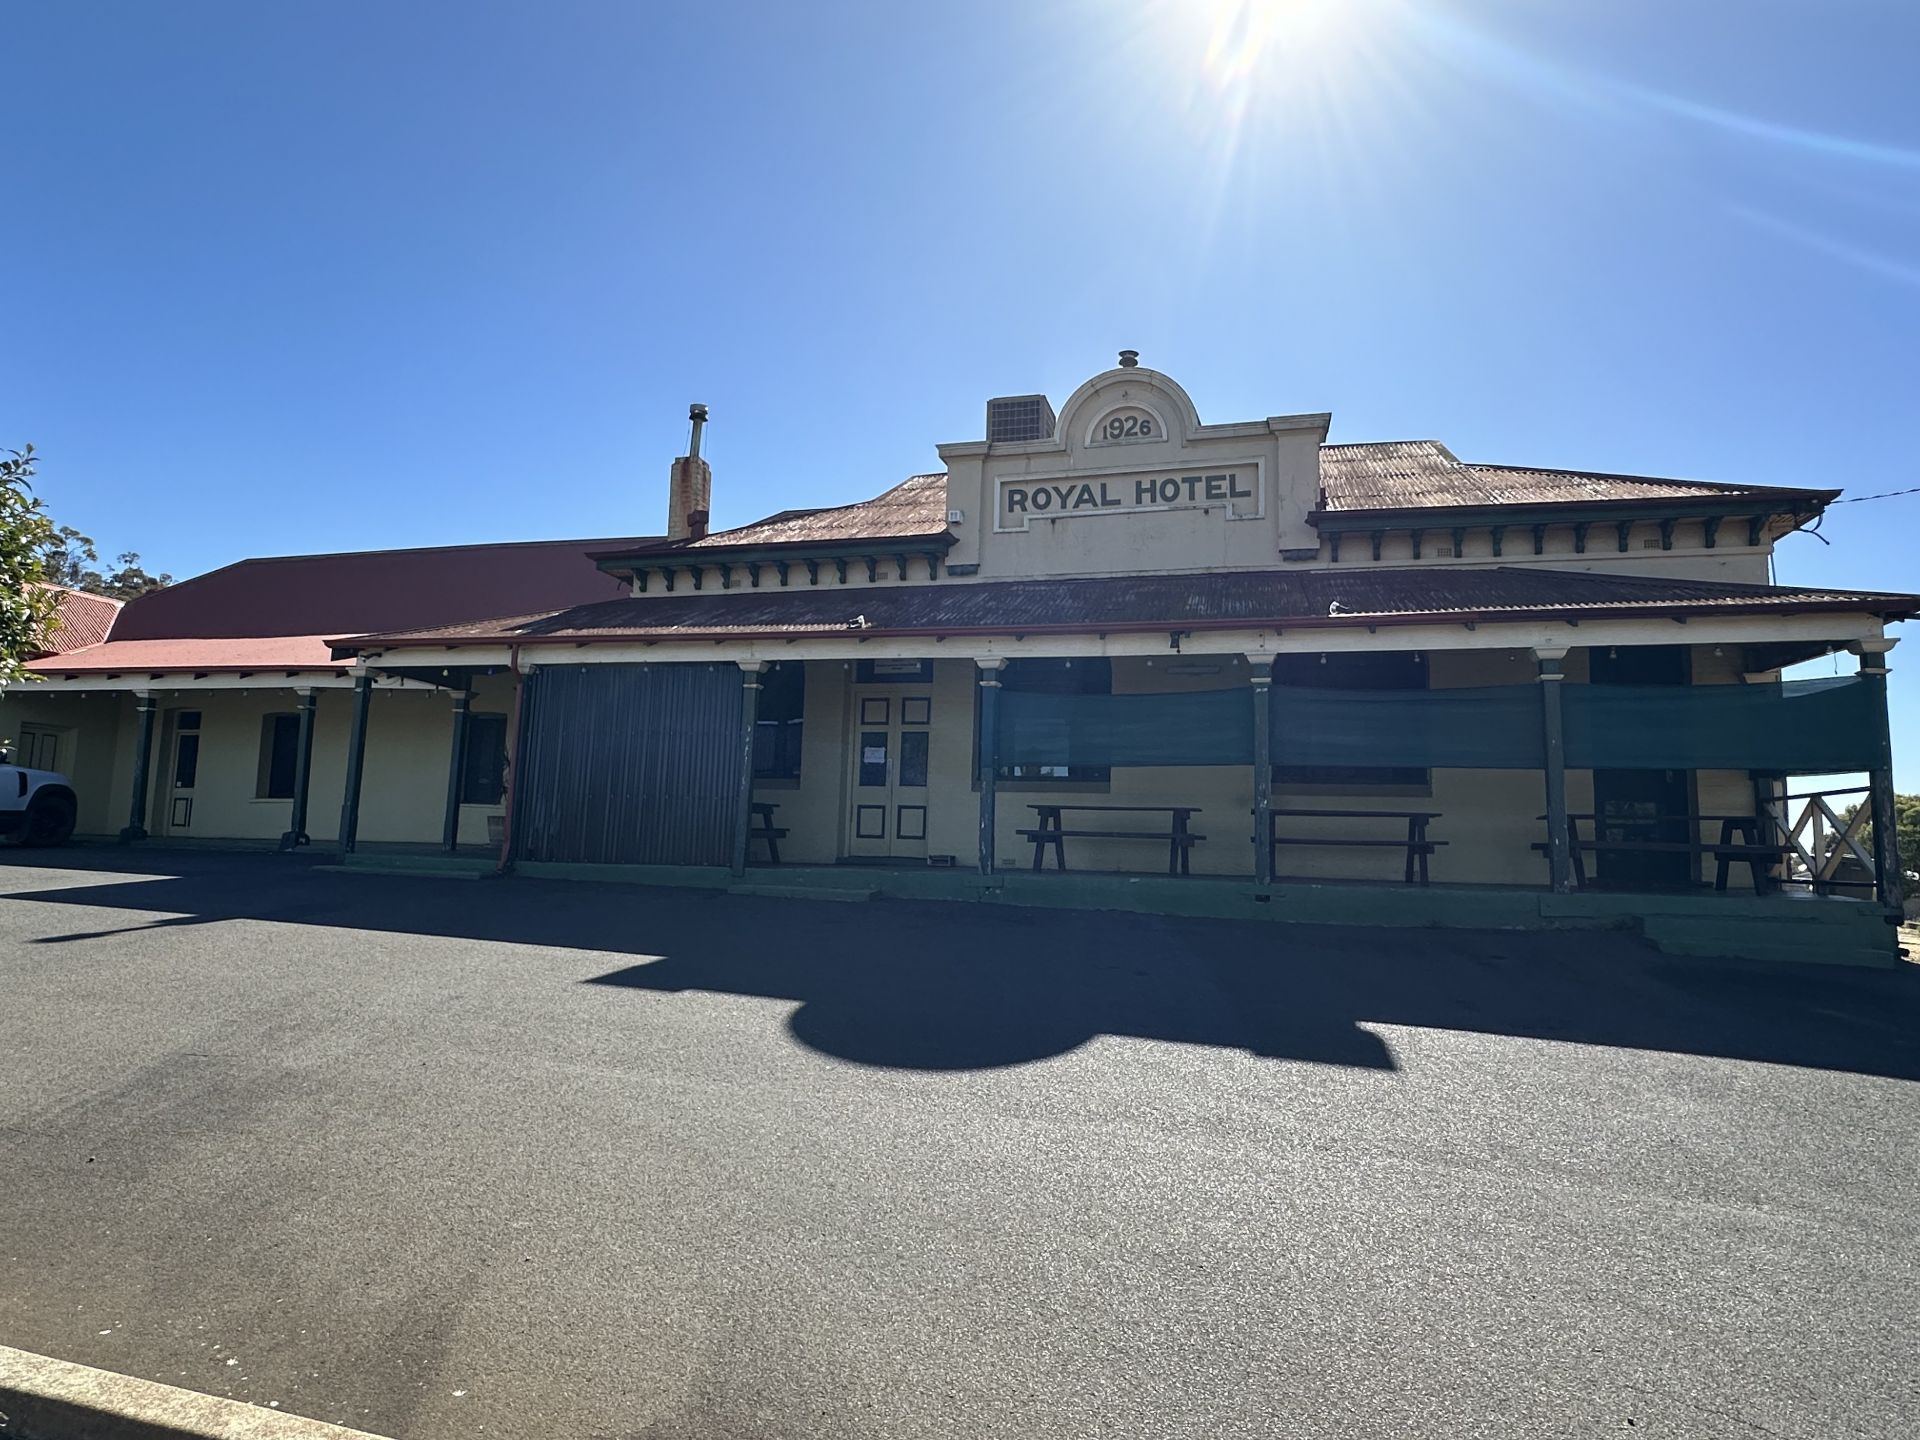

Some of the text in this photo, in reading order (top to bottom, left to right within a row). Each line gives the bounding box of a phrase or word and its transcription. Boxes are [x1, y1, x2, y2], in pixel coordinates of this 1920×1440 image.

[1102, 415, 1151, 440] 1926
[1007, 474, 1251, 513] ROYAL HOTEL
